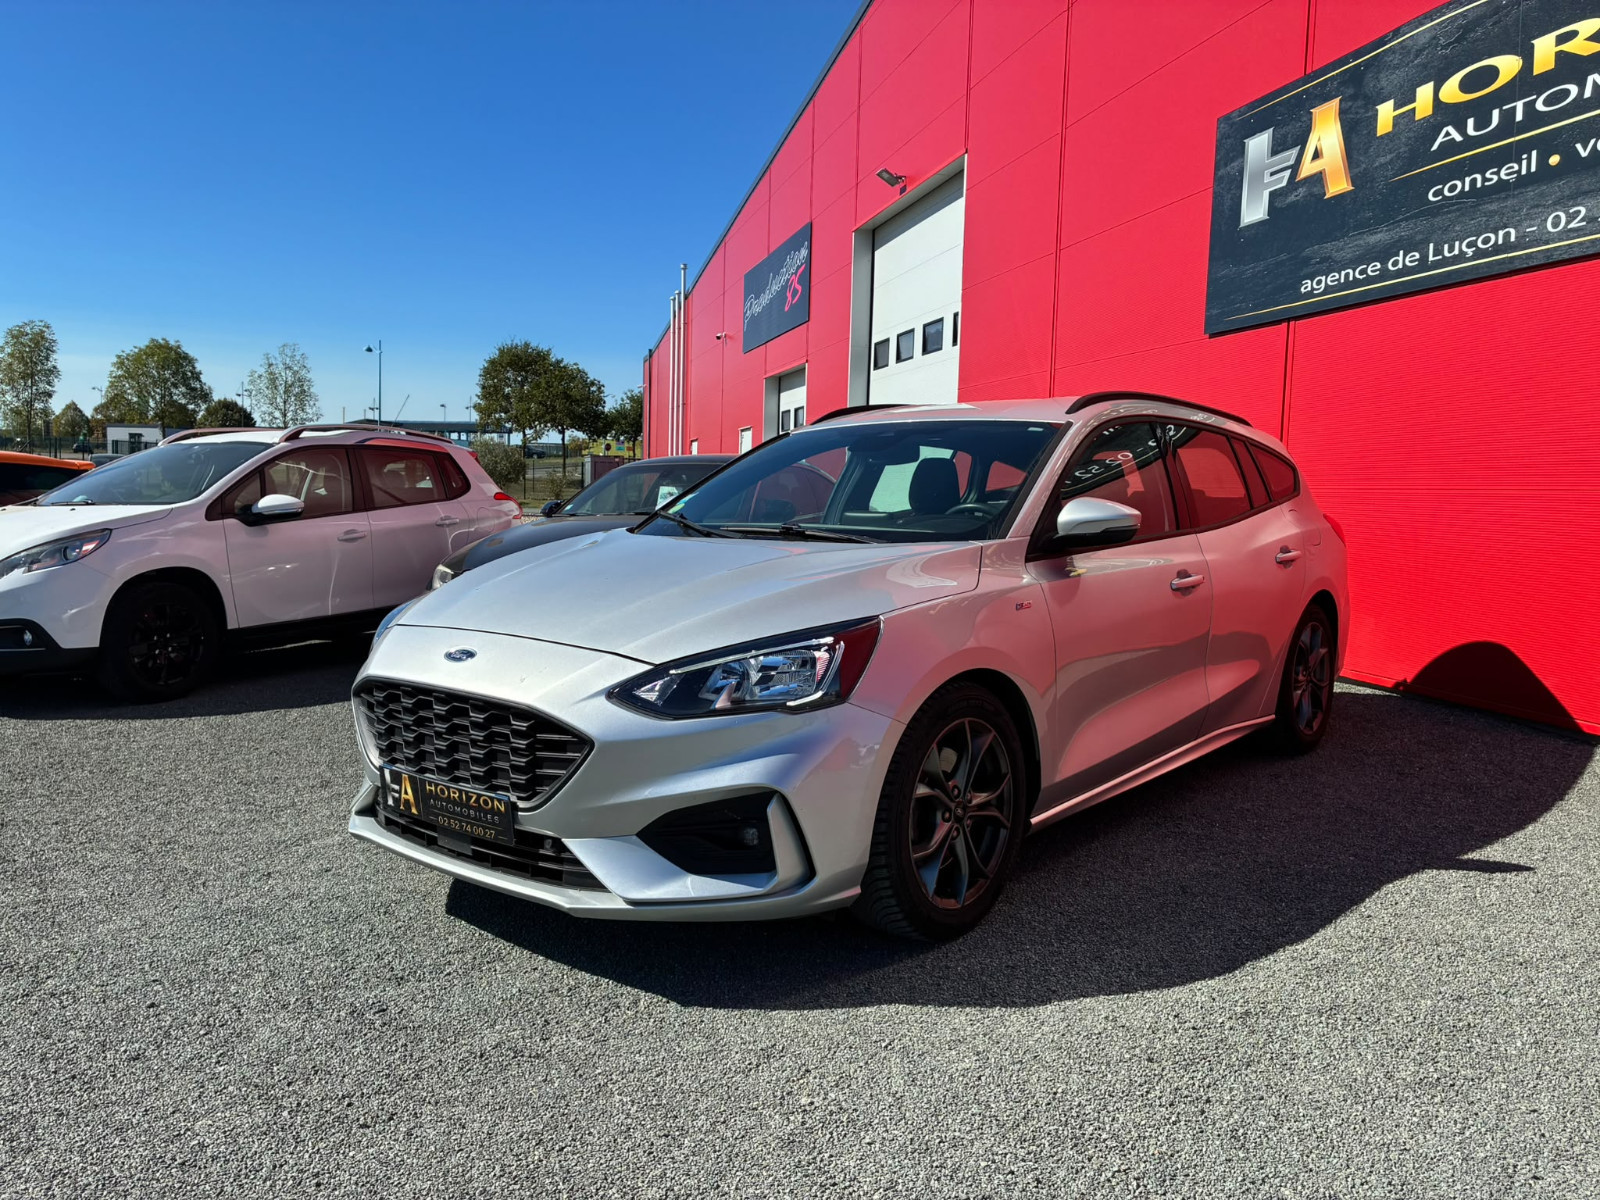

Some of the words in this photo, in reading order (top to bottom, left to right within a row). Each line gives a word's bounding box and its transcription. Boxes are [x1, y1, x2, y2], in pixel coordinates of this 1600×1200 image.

[1427, 149, 1537, 202] conseil
[1300, 260, 1381, 294] agence
[1387, 250, 1419, 272] de
[1427, 227, 1516, 258] Luçon
[1546, 206, 1587, 233] 02
[784, 263, 806, 312] 85
[425, 781, 506, 813] HORIZON
[430, 799, 500, 824] AUTOMOBILES
[438, 815, 449, 826] 02
[450, 819, 460, 830] 52
[473, 825, 484, 837] 00
[485, 829, 496, 839] 27
